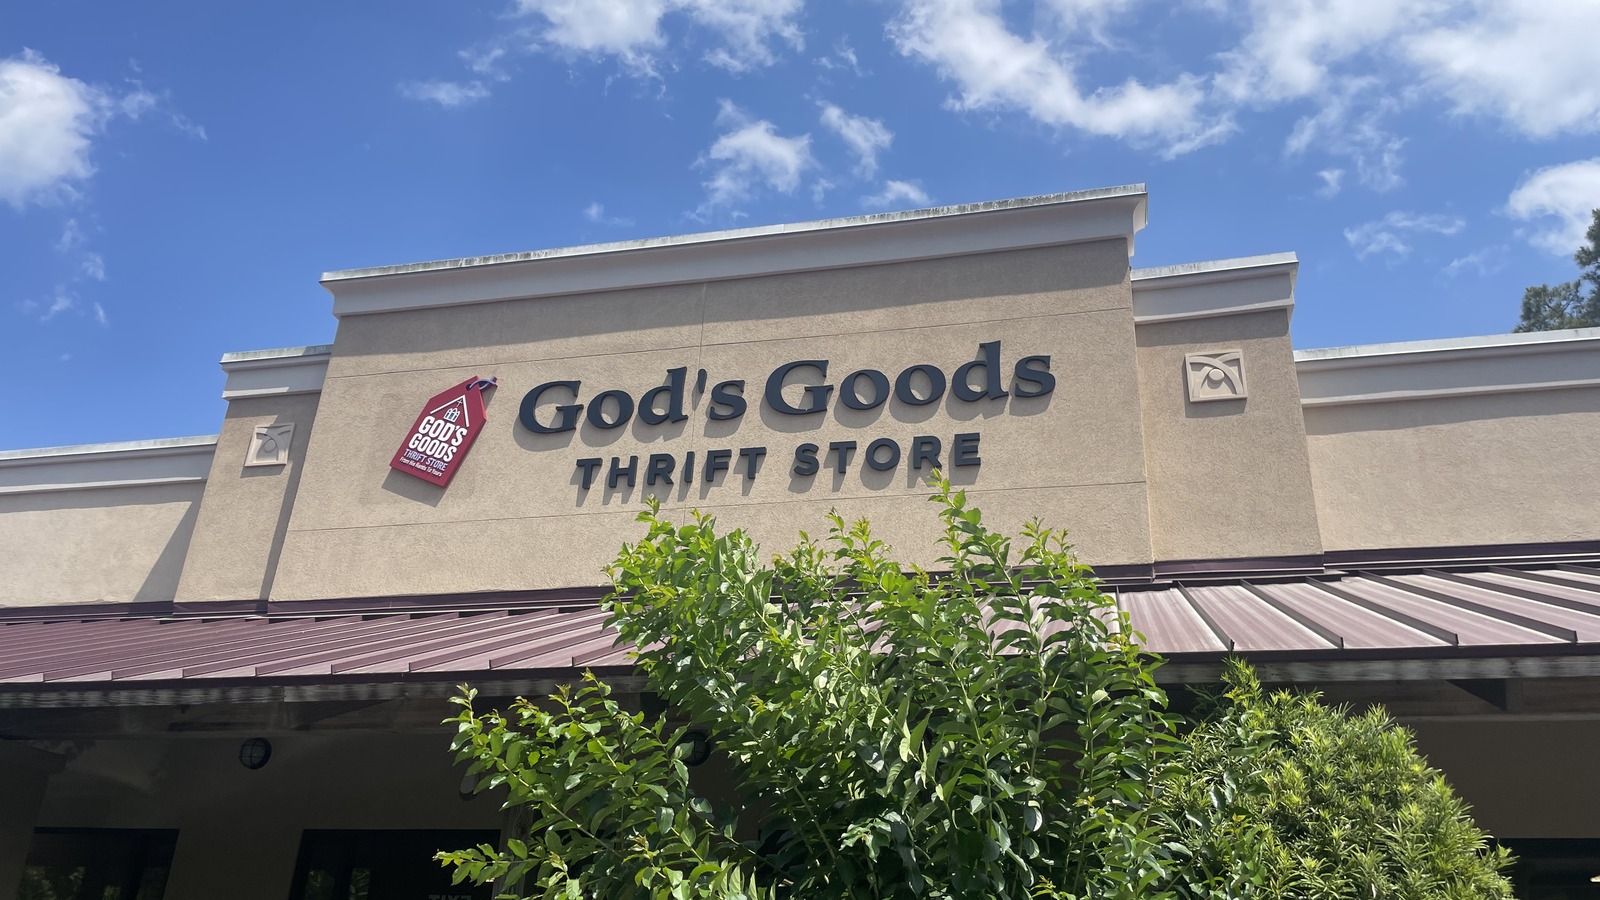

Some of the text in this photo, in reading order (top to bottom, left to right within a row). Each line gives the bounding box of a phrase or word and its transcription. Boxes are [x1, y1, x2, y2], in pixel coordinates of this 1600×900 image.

[518, 340, 1057, 434] God's Goods
[418, 415, 468, 446] GOD'S
[403, 448, 448, 471] THRIFT STORE
[408, 433, 457, 462] GOODS
[575, 432, 982, 490] THRIFT STORE
[431, 469, 443, 477] Yours
